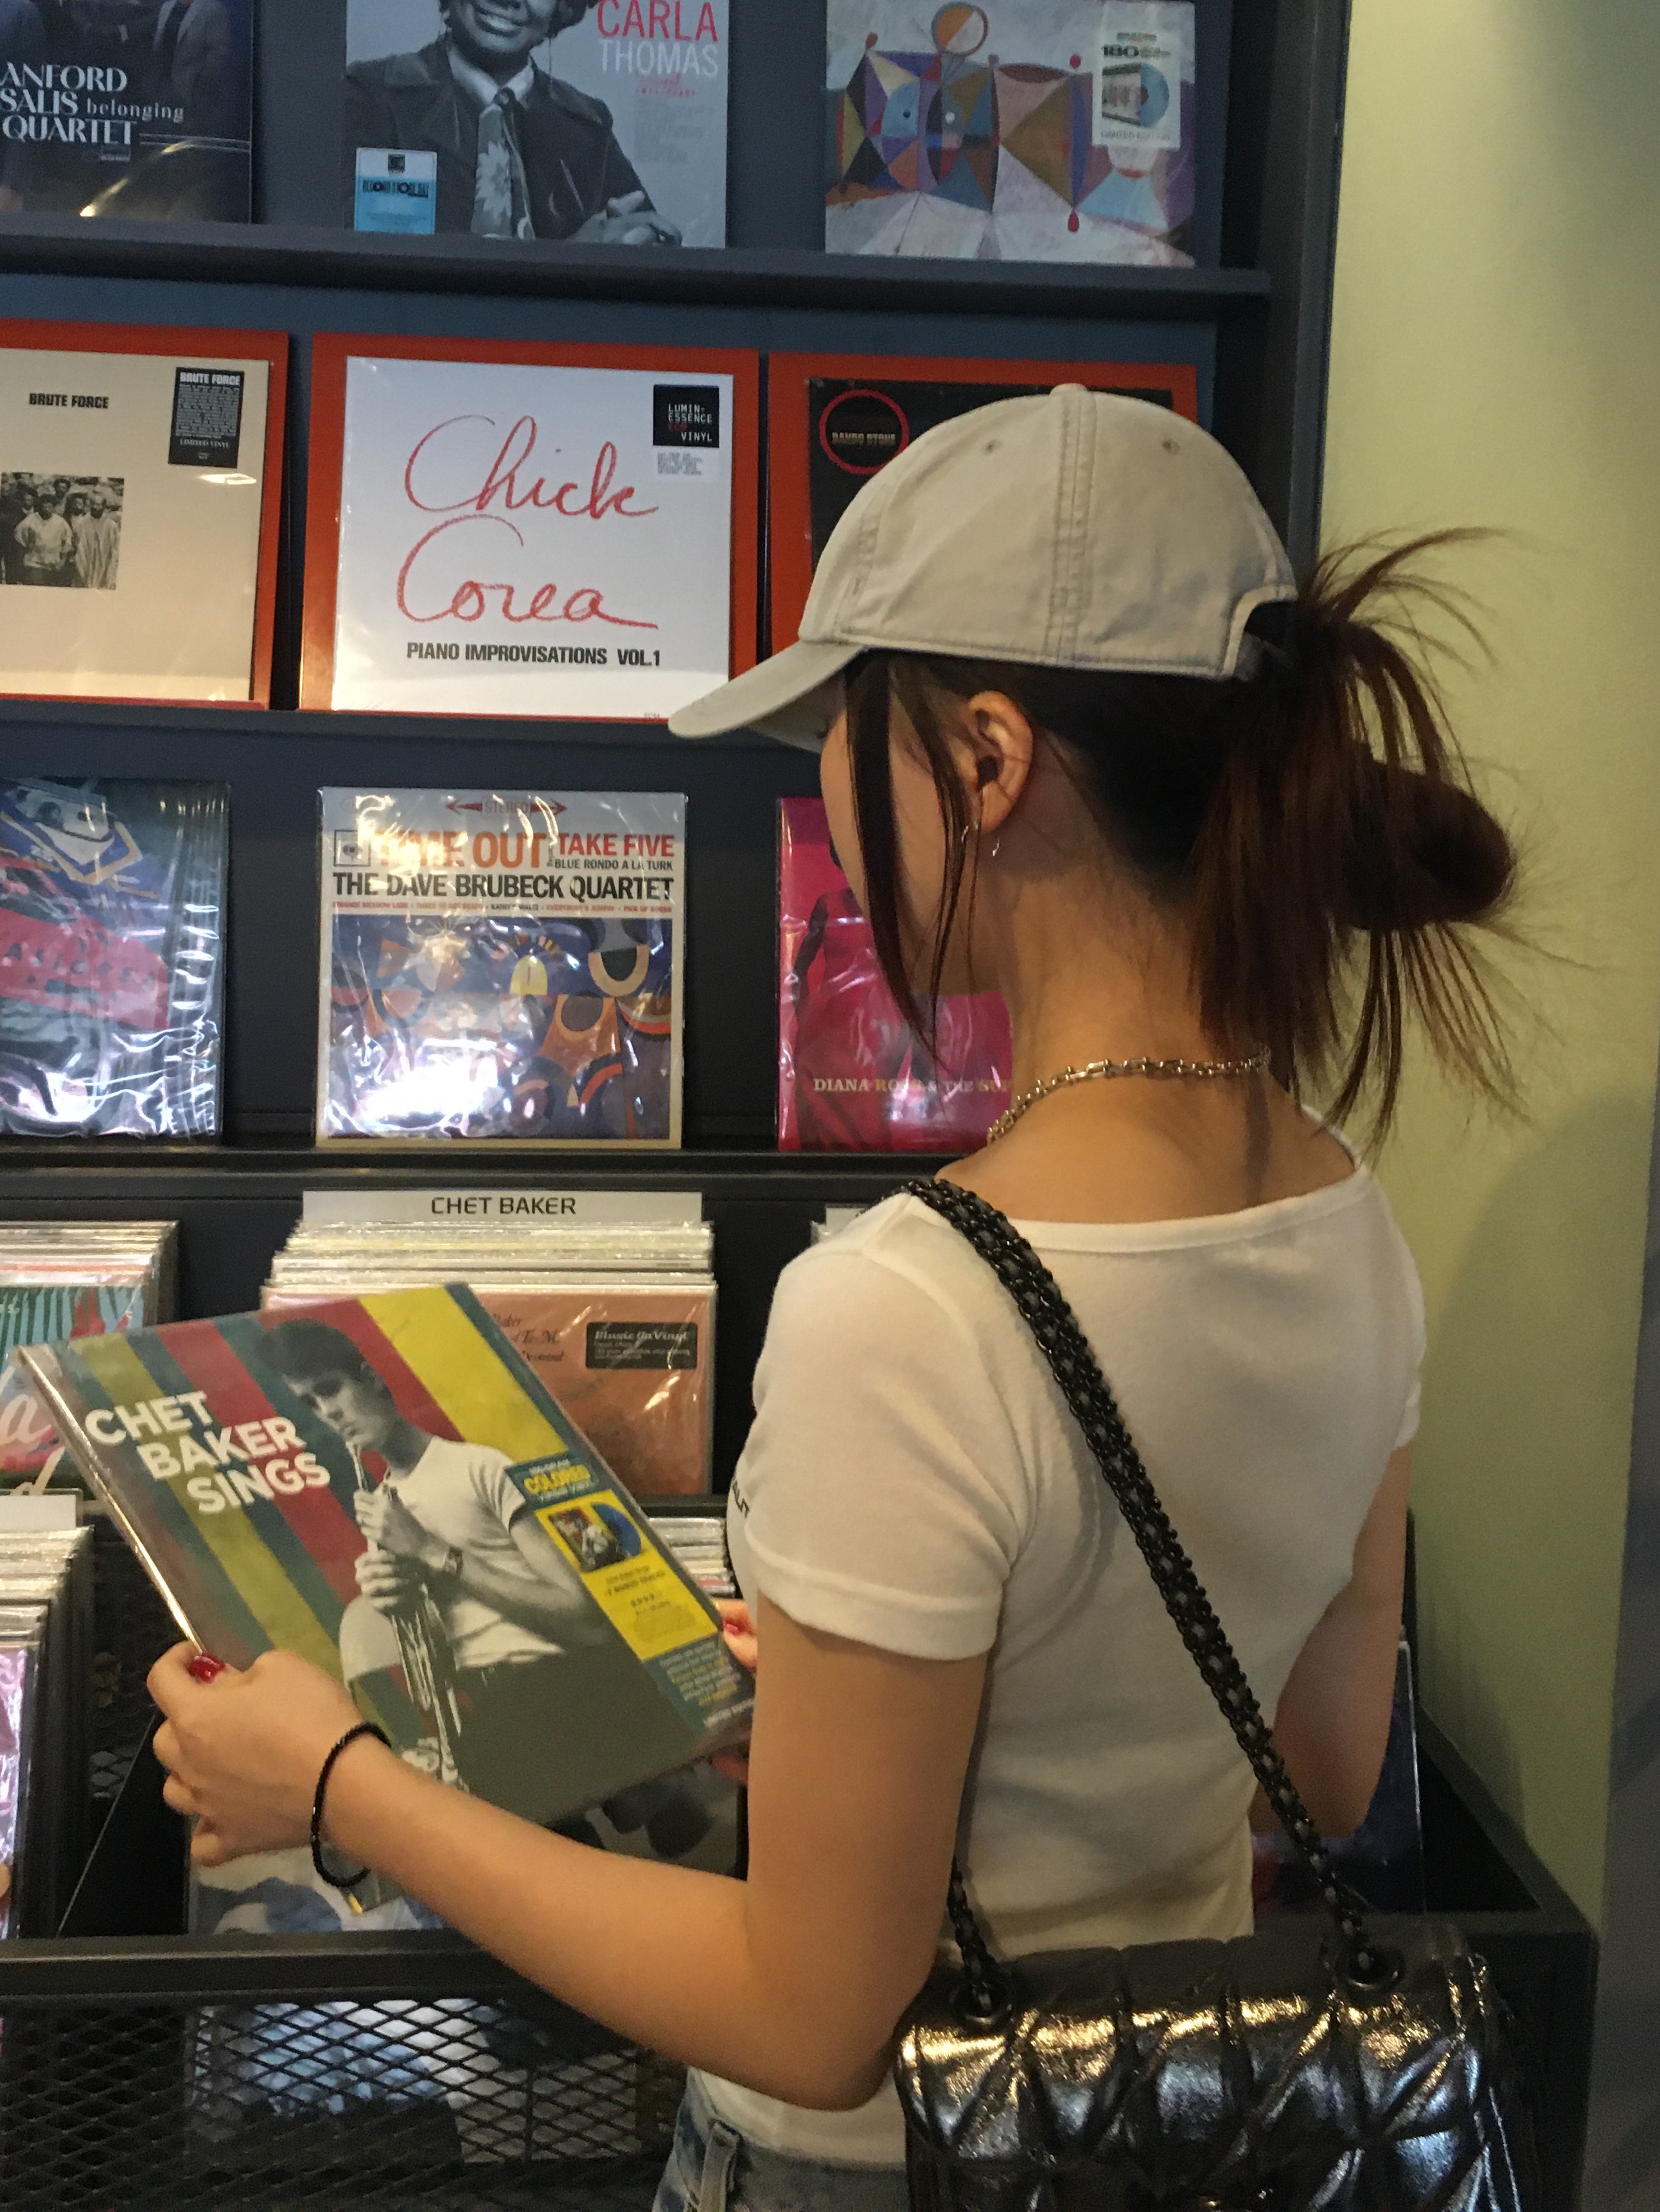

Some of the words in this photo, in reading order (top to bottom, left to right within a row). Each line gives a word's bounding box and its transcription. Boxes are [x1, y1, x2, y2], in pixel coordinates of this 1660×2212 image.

[597, 0, 718, 42] CARLA
[597, 39, 719, 78] THOMAS
[87, 97, 184, 123] belonging
[2, 114, 137, 145] QUARTET
[180, 372, 209, 384] BRUTE
[29, 393, 68, 407] BRUTE
[71, 395, 110, 409] FORCE
[668, 412, 712, 425] ESSENCE
[681, 432, 712, 443] VINYL
[405, 414, 659, 519] Chick
[397, 514, 659, 630] Corea
[407, 642, 461, 660] PIANO
[465, 644, 608, 664] IMPROVISATIONS
[472, 831, 546, 869] OUT
[558, 833, 617, 856] TAKE
[623, 834, 675, 857] FIVE
[554, 858, 580, 869] BLUE
[584, 860, 619, 871] RONDO
[621, 861, 630, 870] A
[631, 861, 644, 871] LA
[647, 860, 674, 871] TURK
[333, 872, 379, 896] THE
[387, 873, 448, 897] DAVE
[455, 874, 564, 898] BRUBECK
[570, 876, 675, 903] QUARTET
[813, 1078, 870, 1092] DIANA
[431, 1196, 492, 1216] CHET
[500, 1198, 577, 1216] BAKER
[85, 1390, 213, 1446] CHET
[136, 1416, 307, 1482] BAKER
[187, 1452, 330, 1514] SINGS
